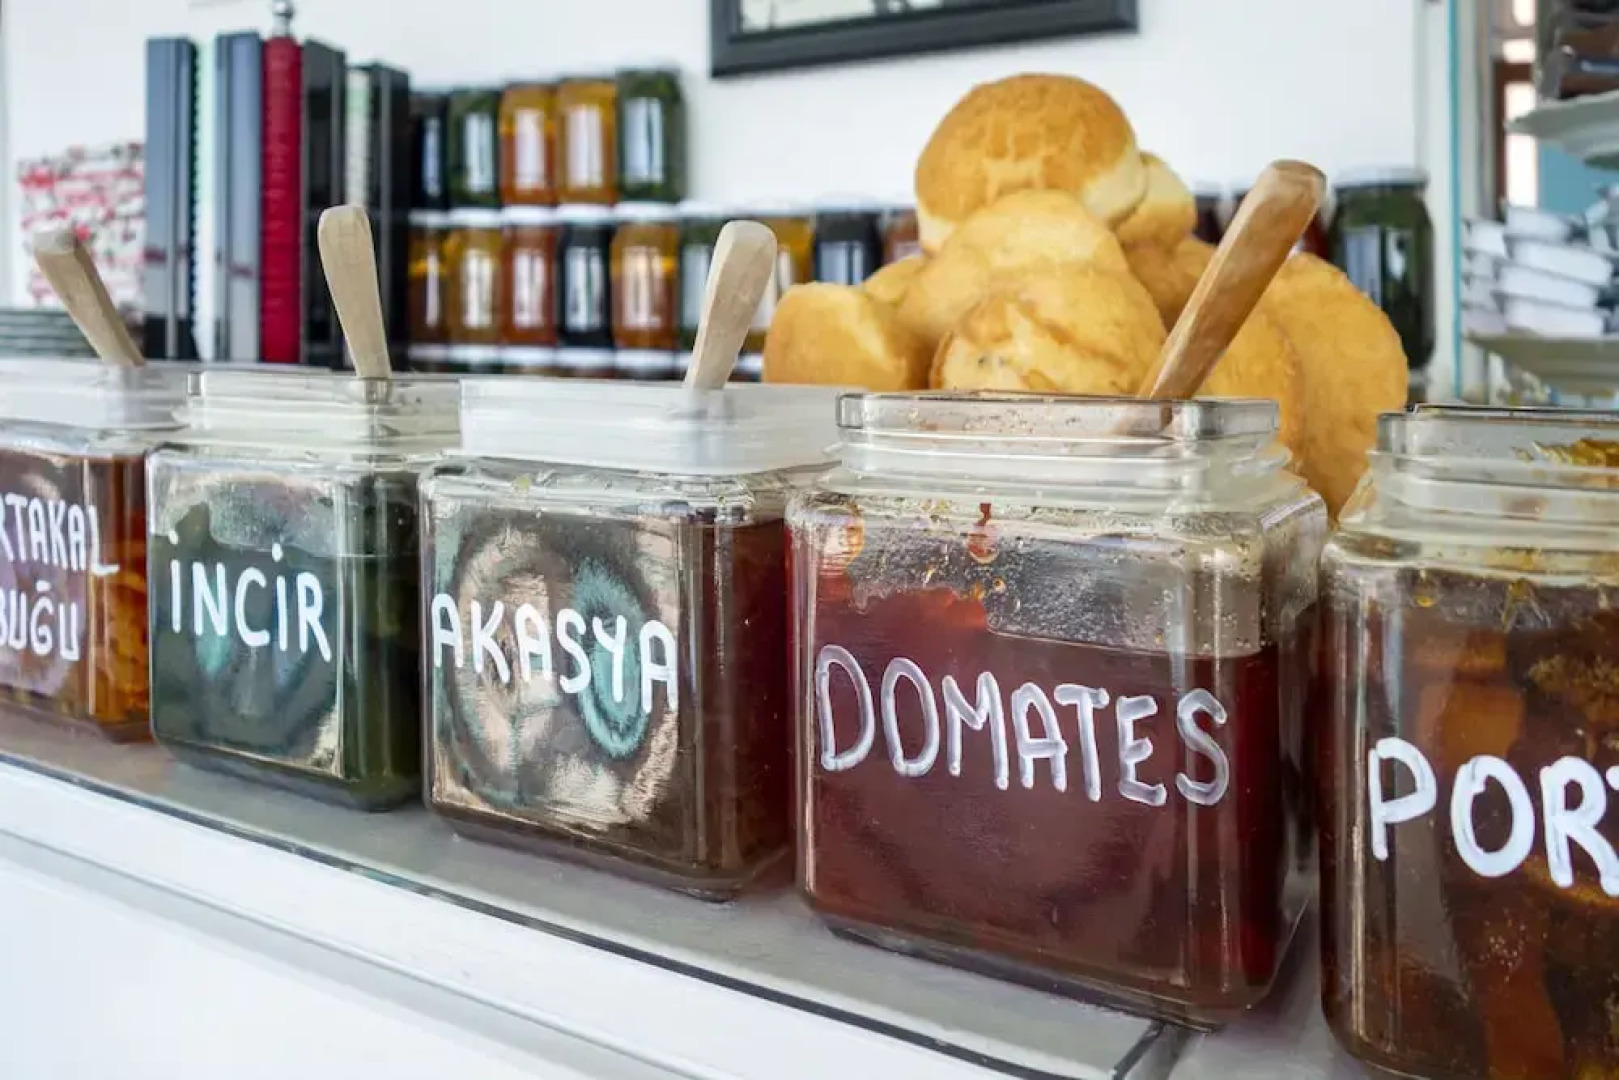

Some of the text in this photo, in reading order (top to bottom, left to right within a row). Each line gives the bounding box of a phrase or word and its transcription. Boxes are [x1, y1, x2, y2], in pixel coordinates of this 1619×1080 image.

[168, 530, 331, 662] İNCİR
[431, 593, 679, 714] AKASYA
[815, 644, 1230, 806] DOMATES
[1368, 736, 1619, 898] POR
